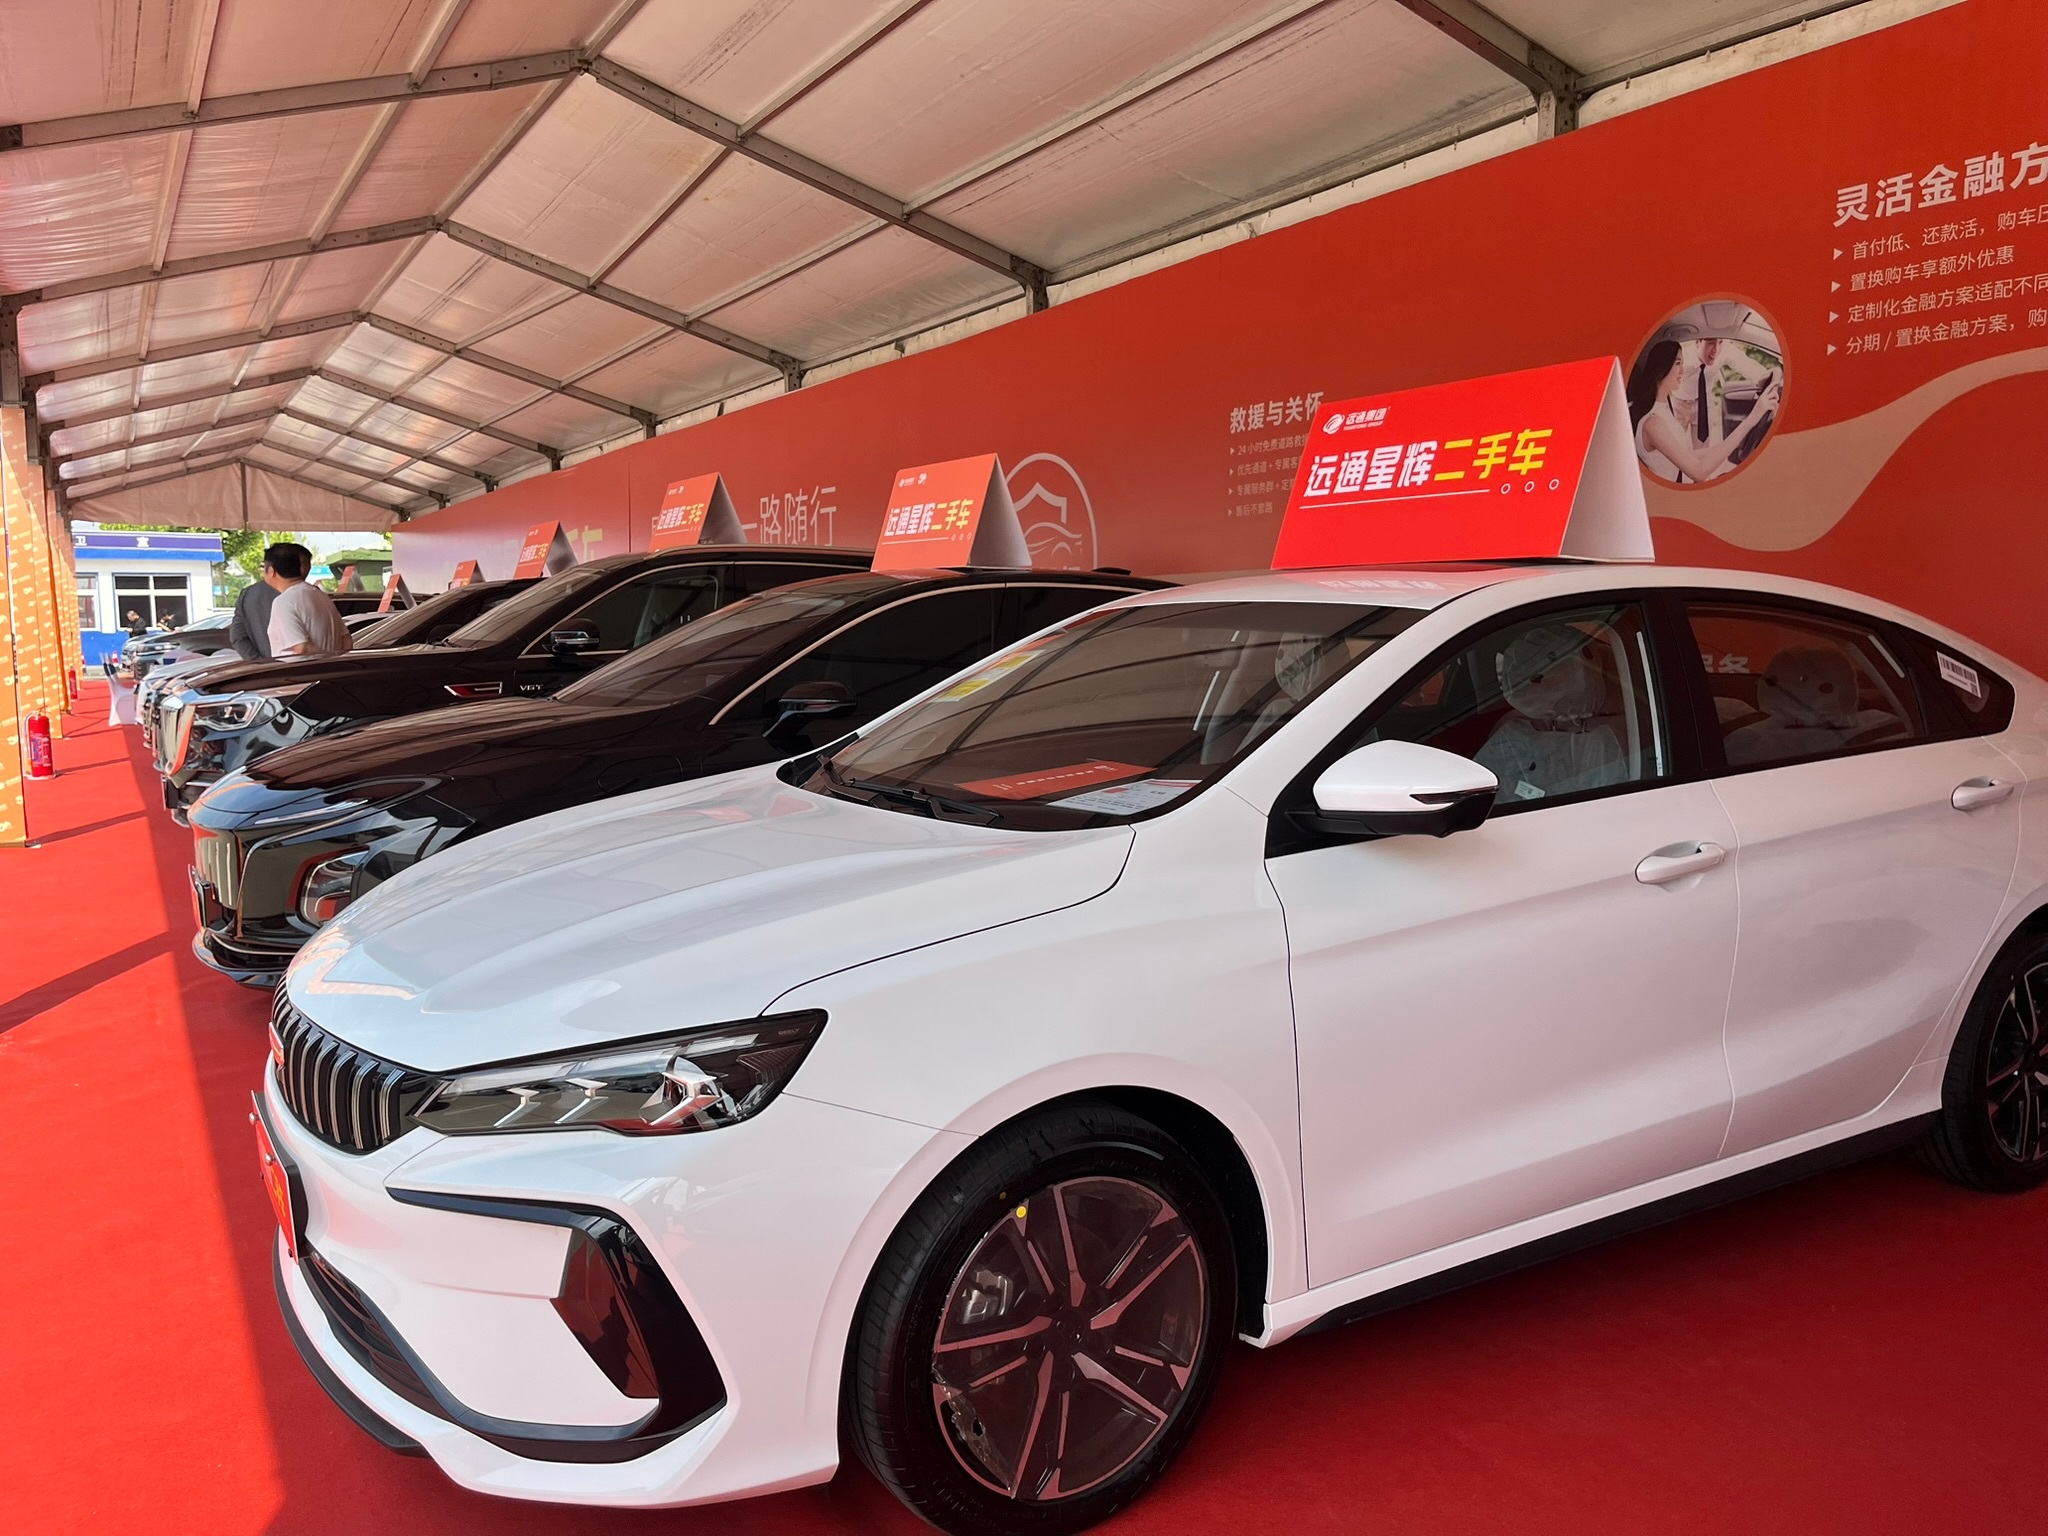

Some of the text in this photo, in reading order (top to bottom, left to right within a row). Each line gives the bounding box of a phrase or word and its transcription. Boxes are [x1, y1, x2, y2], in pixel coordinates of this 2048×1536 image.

[1833, 142, 2048, 228] 灵活金融方
[1850, 245, 2014, 292] 置换购车享额外优惠
[1847, 273, 2048, 324] 定制化金融方案适配不同
[1230, 392, 1324, 434] 救援与关怀
[1303, 428, 1553, 497] 远通星辉二手车
[740, 485, 836, 547] 一路随行
